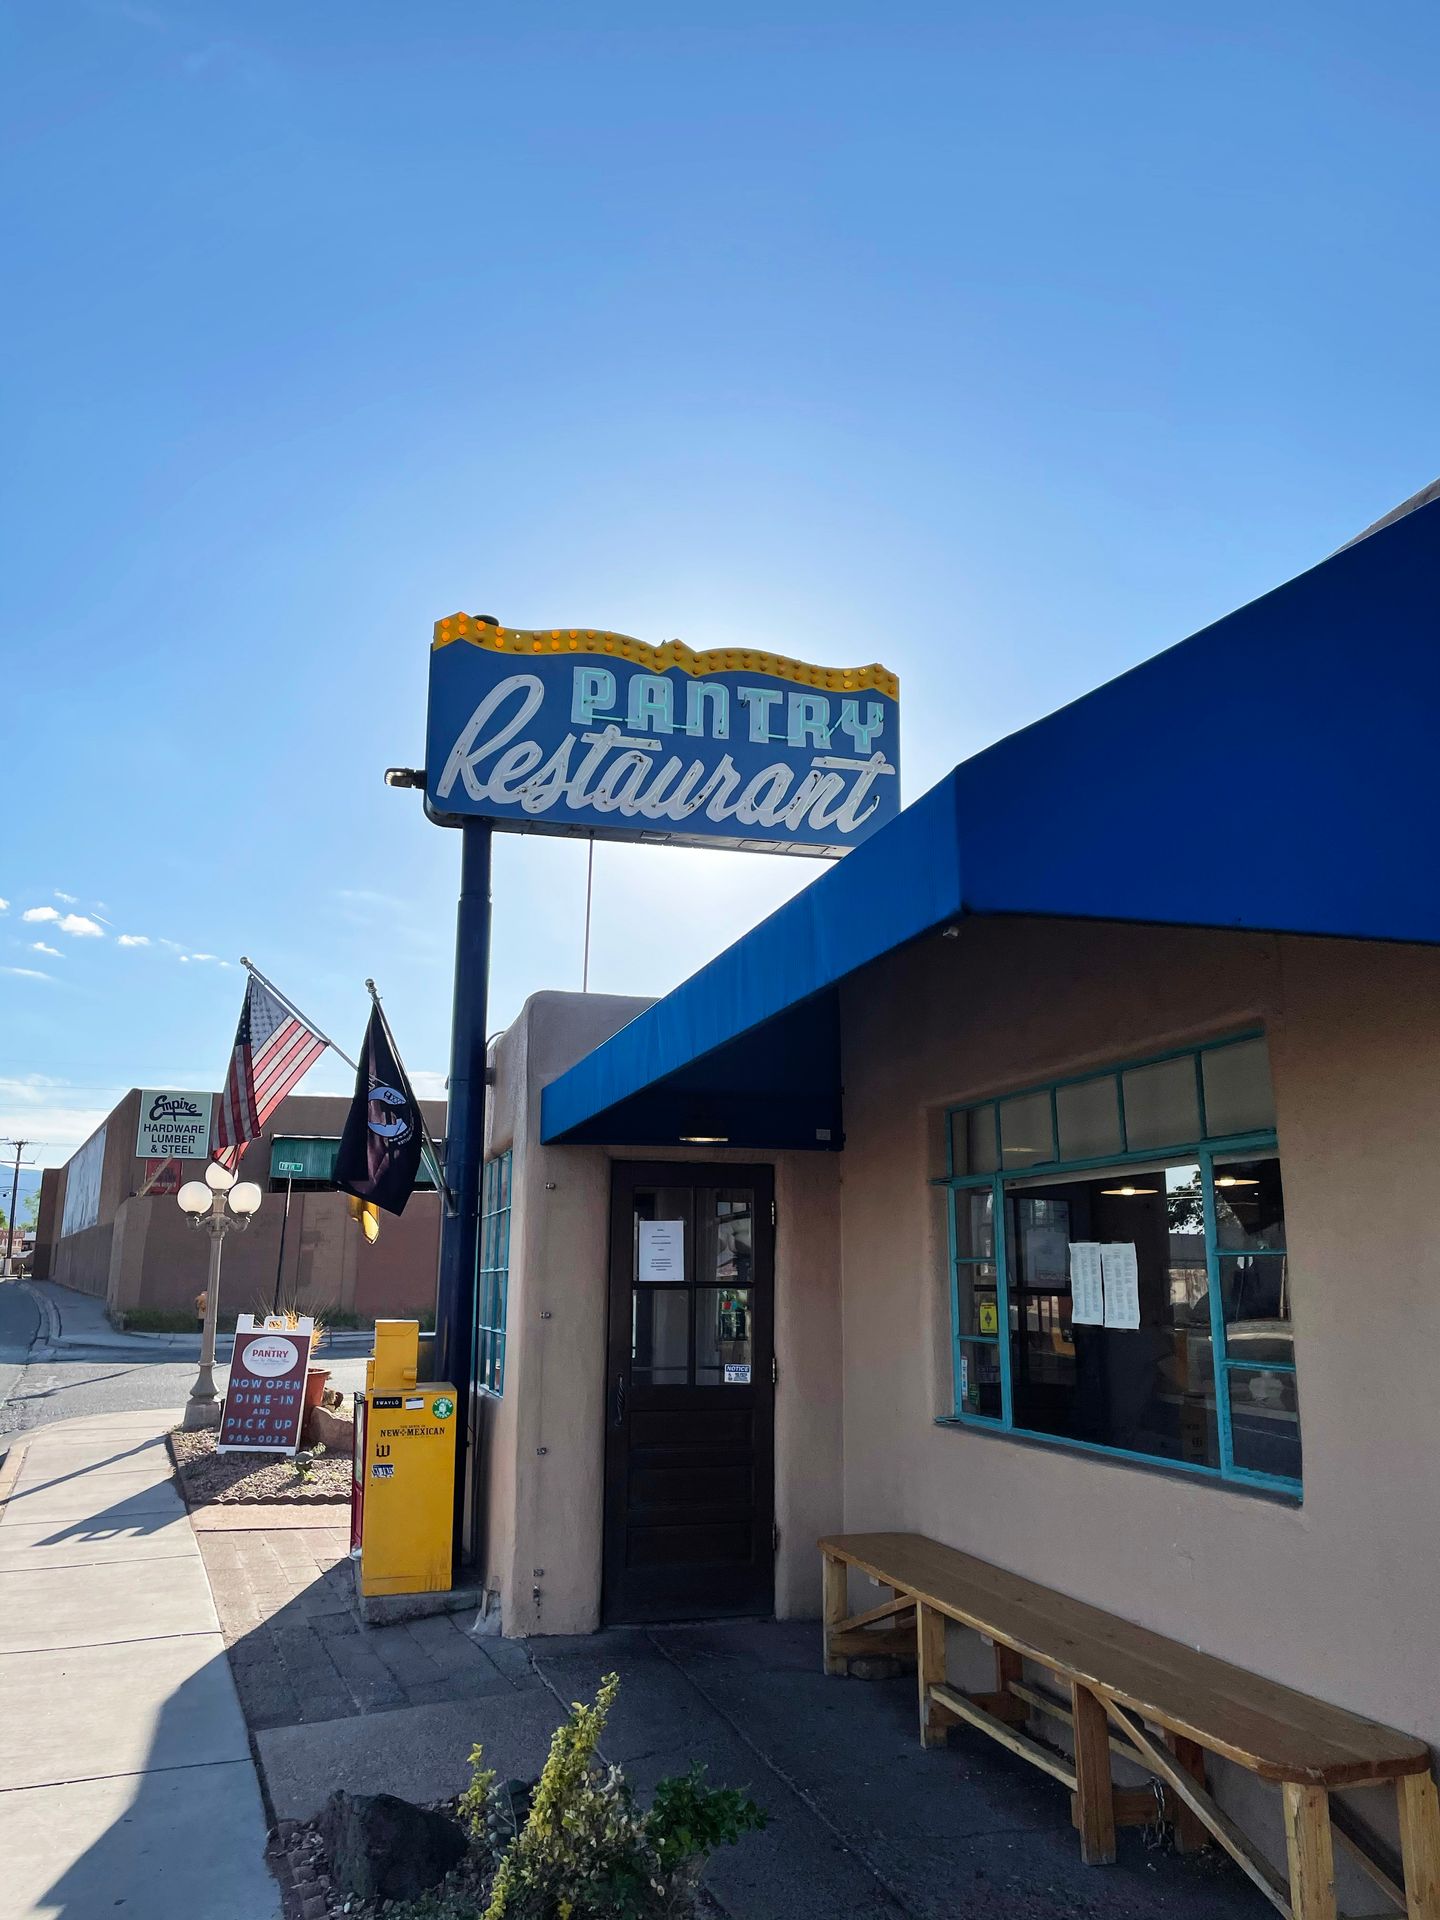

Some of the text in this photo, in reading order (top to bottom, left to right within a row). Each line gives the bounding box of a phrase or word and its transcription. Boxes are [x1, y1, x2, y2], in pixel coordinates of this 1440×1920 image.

[571, 665, 885, 754] PANTRY
[436, 673, 896, 833] Restaurant
[149, 1094, 203, 1122] Empire
[143, 1123, 205, 1134] HARDWARE
[151, 1134, 196, 1144] LUMBER
[150, 1144, 194, 1154] & STEEL
[252, 1349, 290, 1358] PANTRY
[726, 1365, 749, 1373] NOTICE
[231, 1378, 301, 1390] NOW OPEN
[235, 1393, 294, 1405] DINE-IN
[227, 1418, 293, 1430] PICK UP
[380, 1426, 446, 1437] NEW MEXICAN
